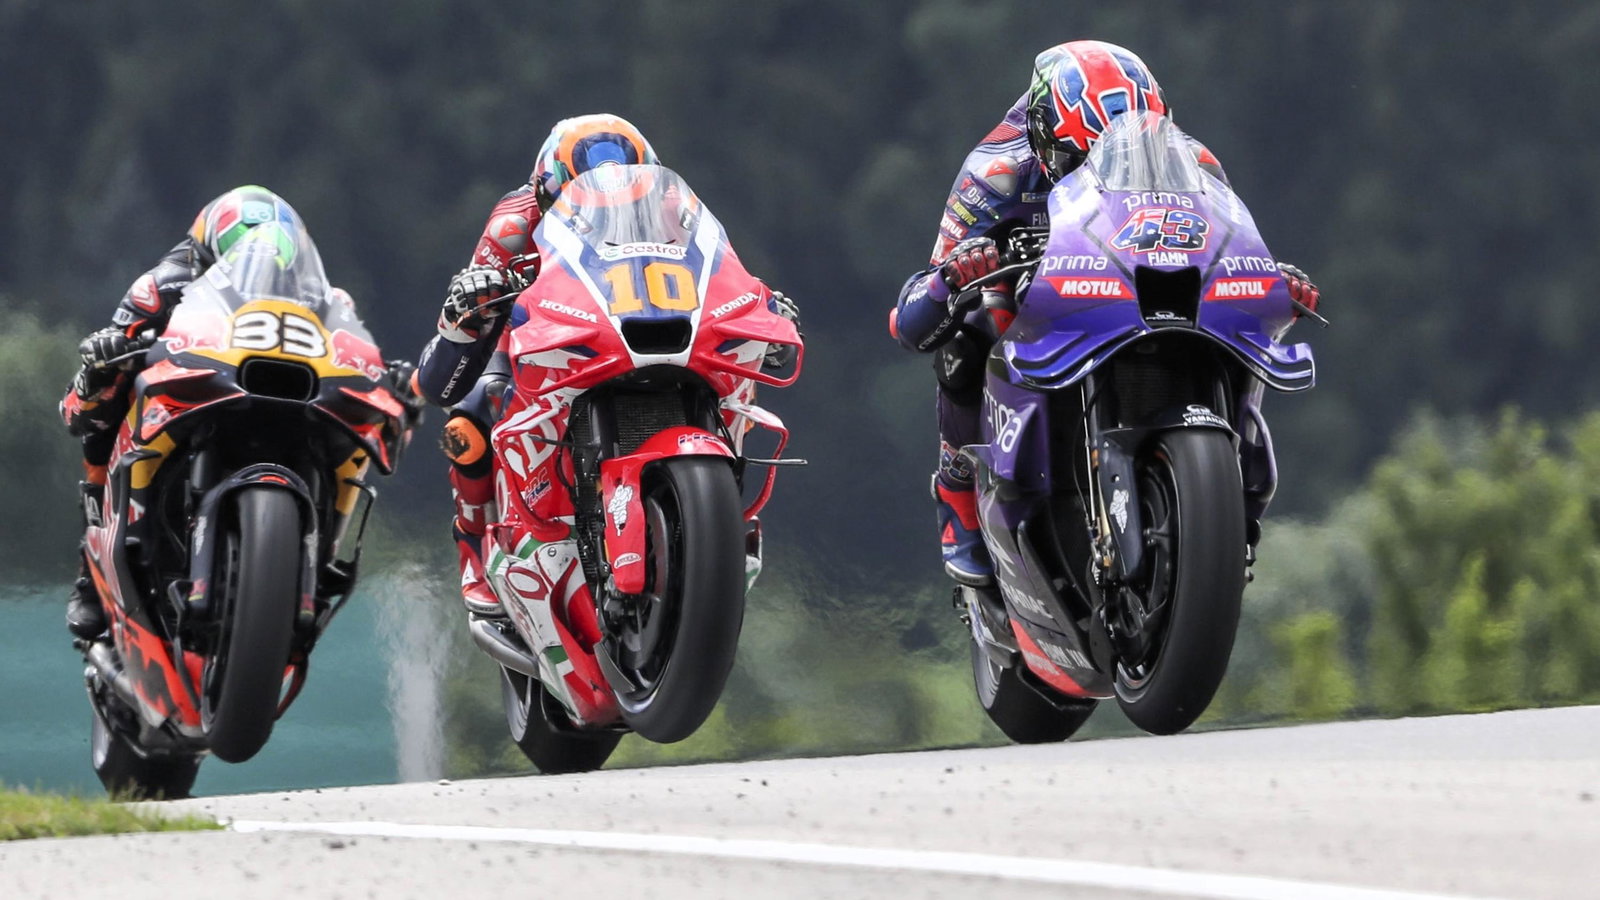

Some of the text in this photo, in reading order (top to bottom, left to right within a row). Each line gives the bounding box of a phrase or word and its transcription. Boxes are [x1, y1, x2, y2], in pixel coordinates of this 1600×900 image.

[1122, 191, 1194, 212] prima
[1109, 207, 1211, 253] 43
[622, 244, 683, 257] Castrol
[1148, 252, 1188, 265] FIAMM
[1041, 255, 1108, 276] prima
[1220, 254, 1277, 276] prima
[602, 260, 701, 315] 10
[1060, 280, 1122, 296] MOTUL
[1215, 280, 1265, 297] MOTUL
[537, 299, 598, 323] HONDA
[710, 291, 758, 318] HONDA
[230, 310, 327, 358] 33
